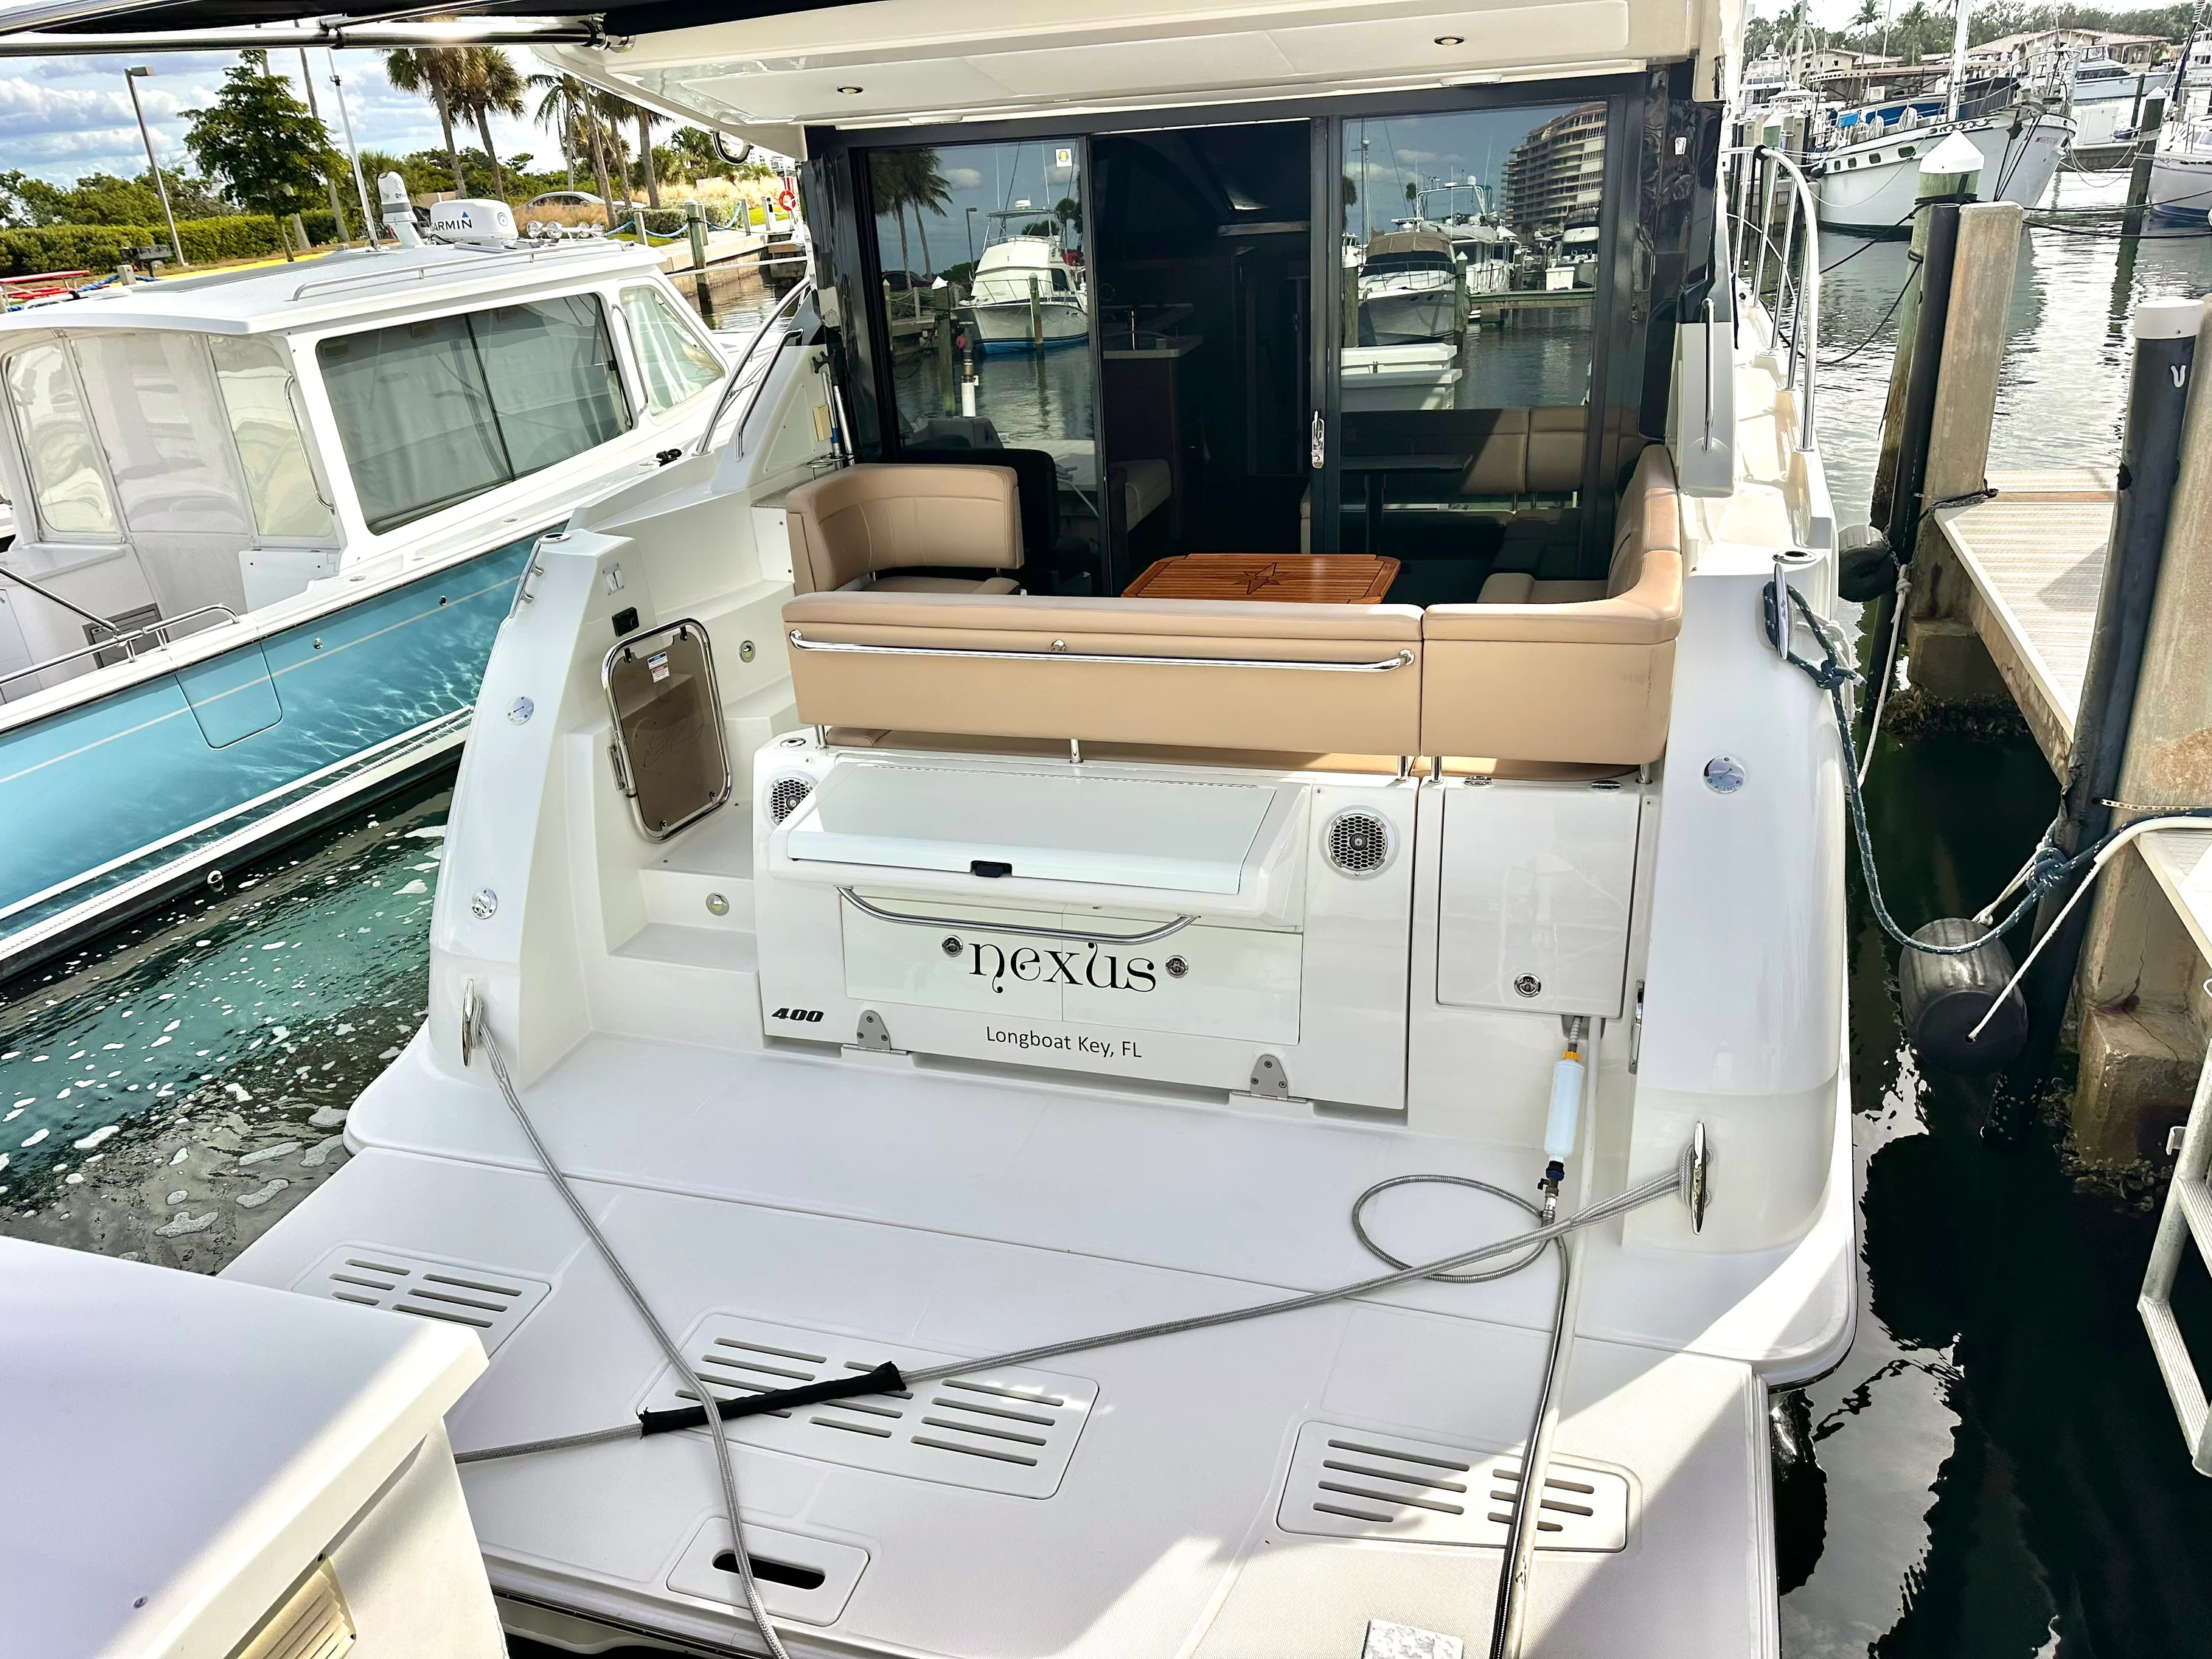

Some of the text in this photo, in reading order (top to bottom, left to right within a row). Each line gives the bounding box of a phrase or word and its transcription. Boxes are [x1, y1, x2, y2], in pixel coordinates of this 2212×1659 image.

[968, 942, 1156, 993] nexus
[771, 1007, 824, 1022] 400
[987, 1026, 1142, 1058] Longboat Key, FL
